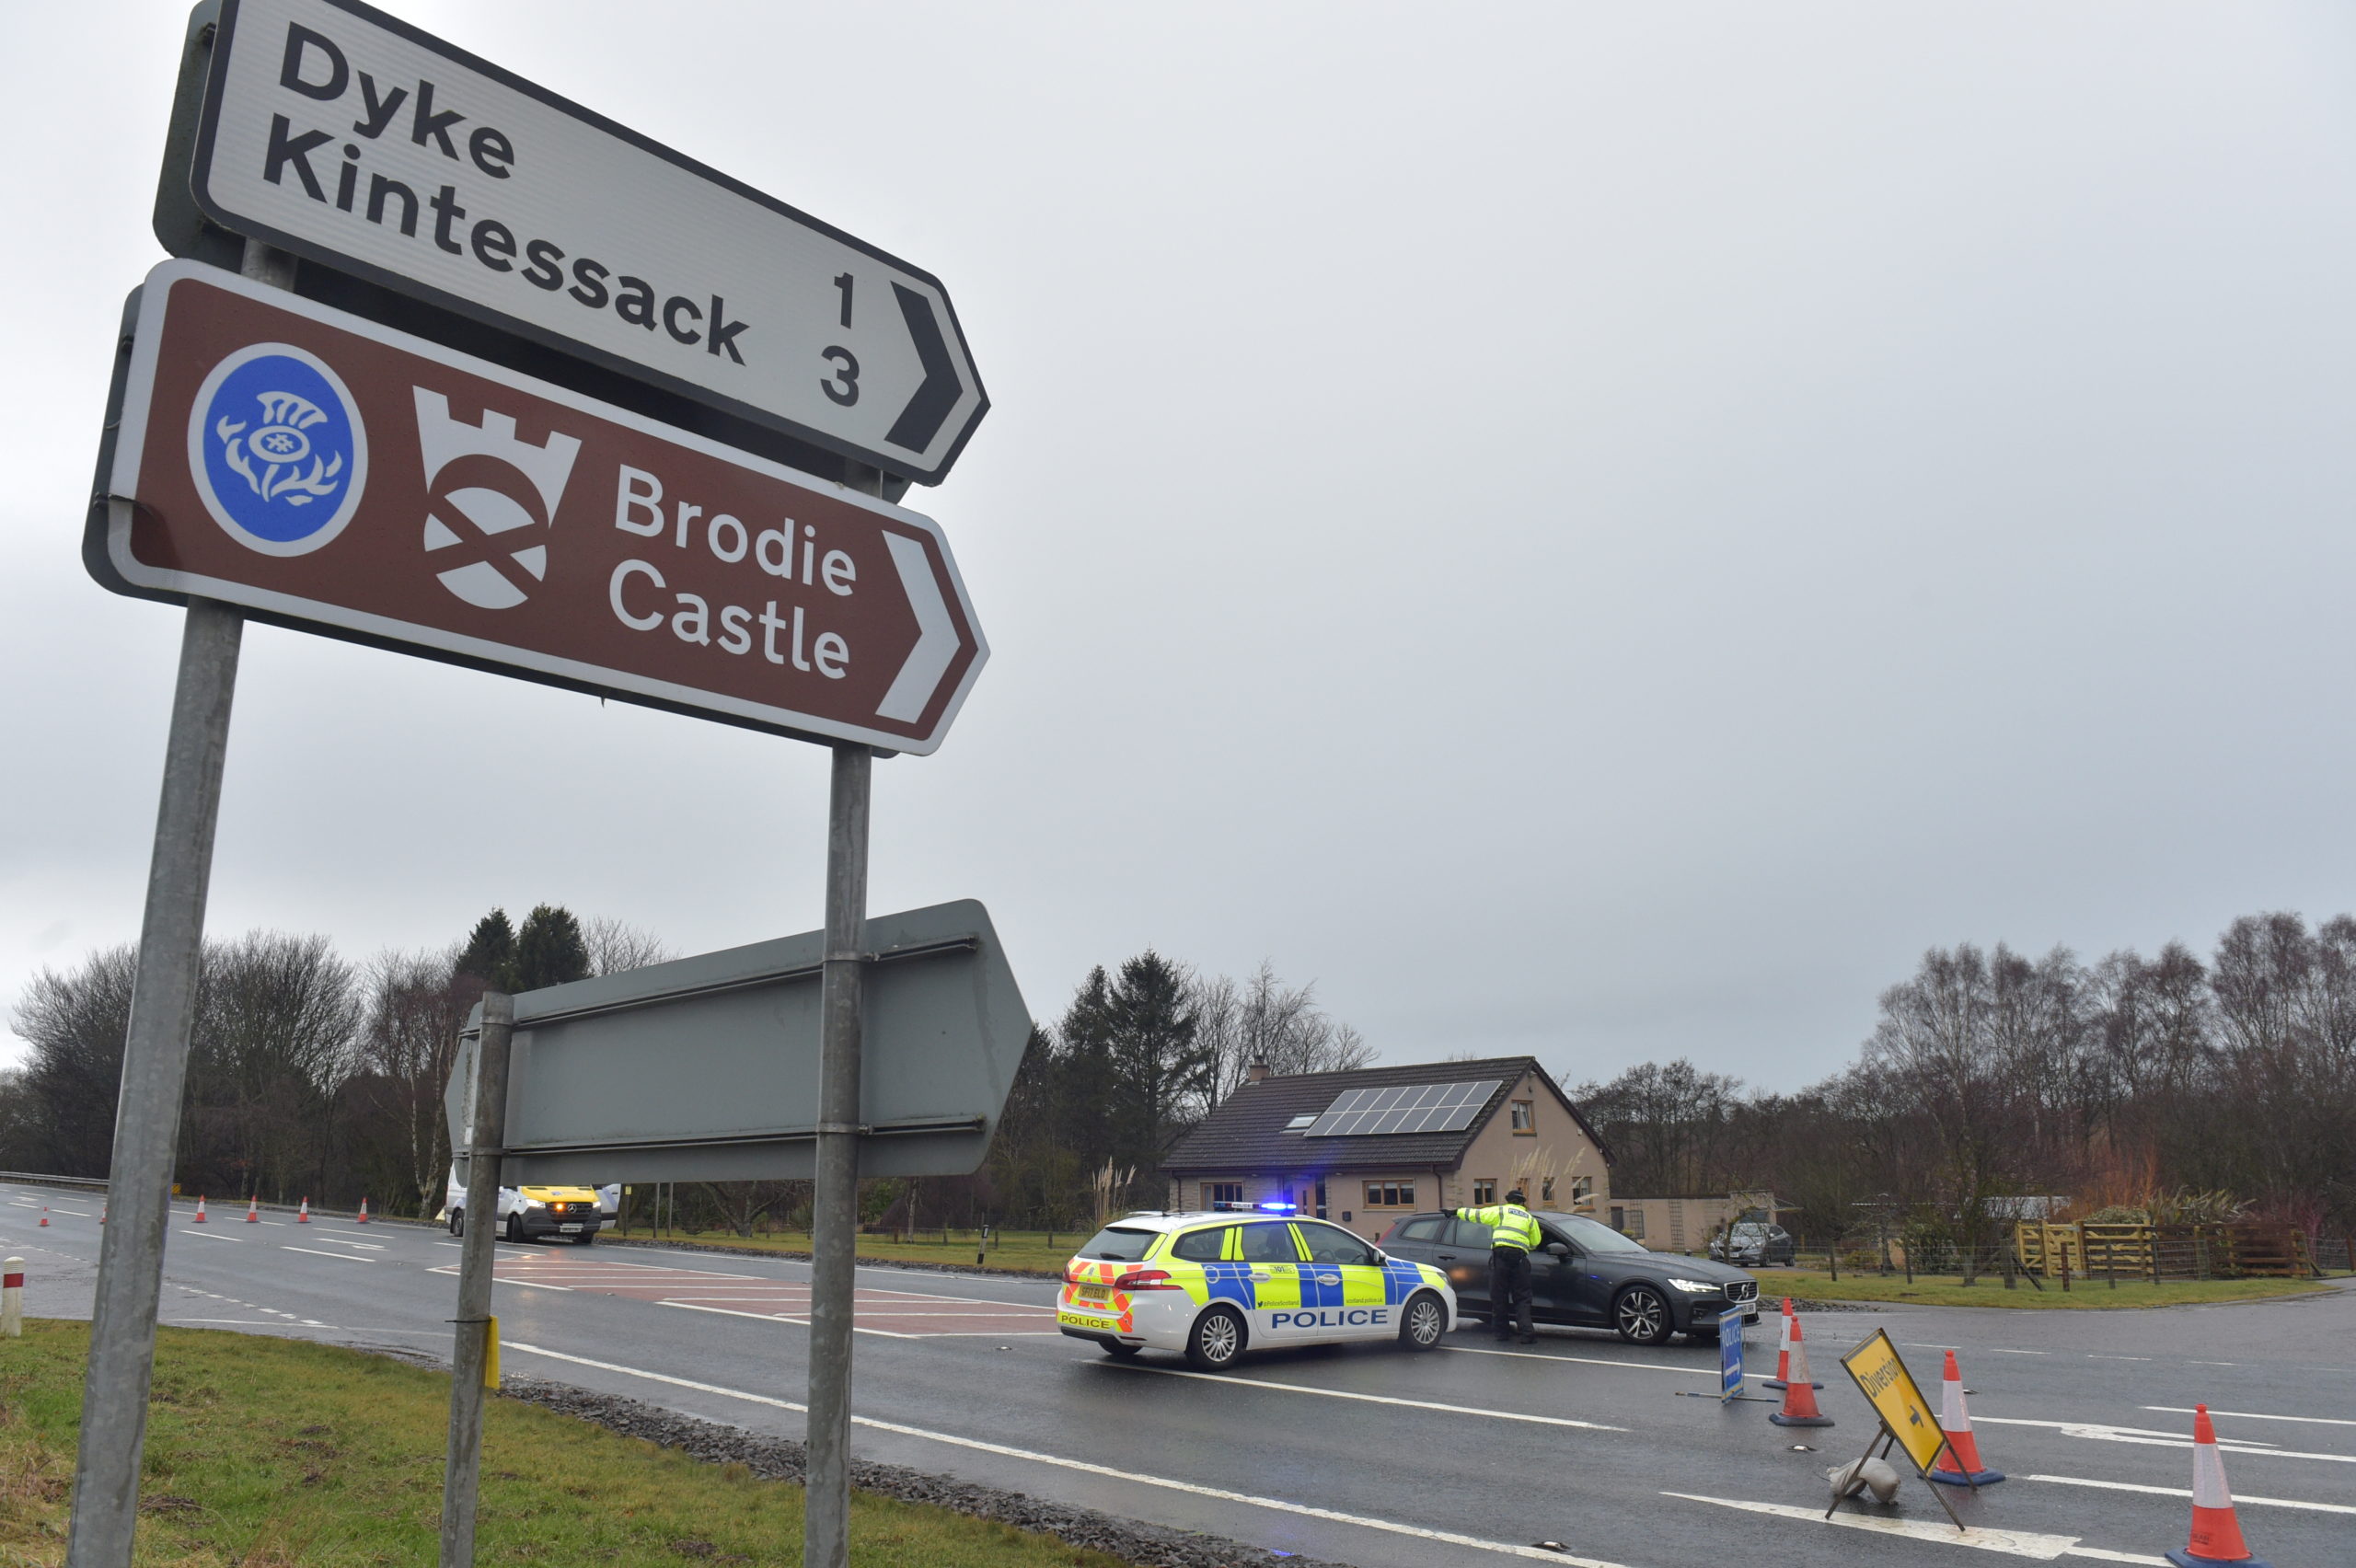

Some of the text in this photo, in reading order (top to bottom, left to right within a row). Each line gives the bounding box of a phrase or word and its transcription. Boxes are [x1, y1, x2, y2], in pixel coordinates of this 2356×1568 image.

[279, 20, 854, 329] Dyke 1
[262, 112, 860, 408] Kintessack 3
[615, 464, 856, 596] Brodie
[609, 559, 849, 679] Castle
[1061, 1314, 1111, 1330] POLICE
[1271, 1309, 1389, 1330] POLICE
[1859, 1356, 1902, 1398] Diversion
